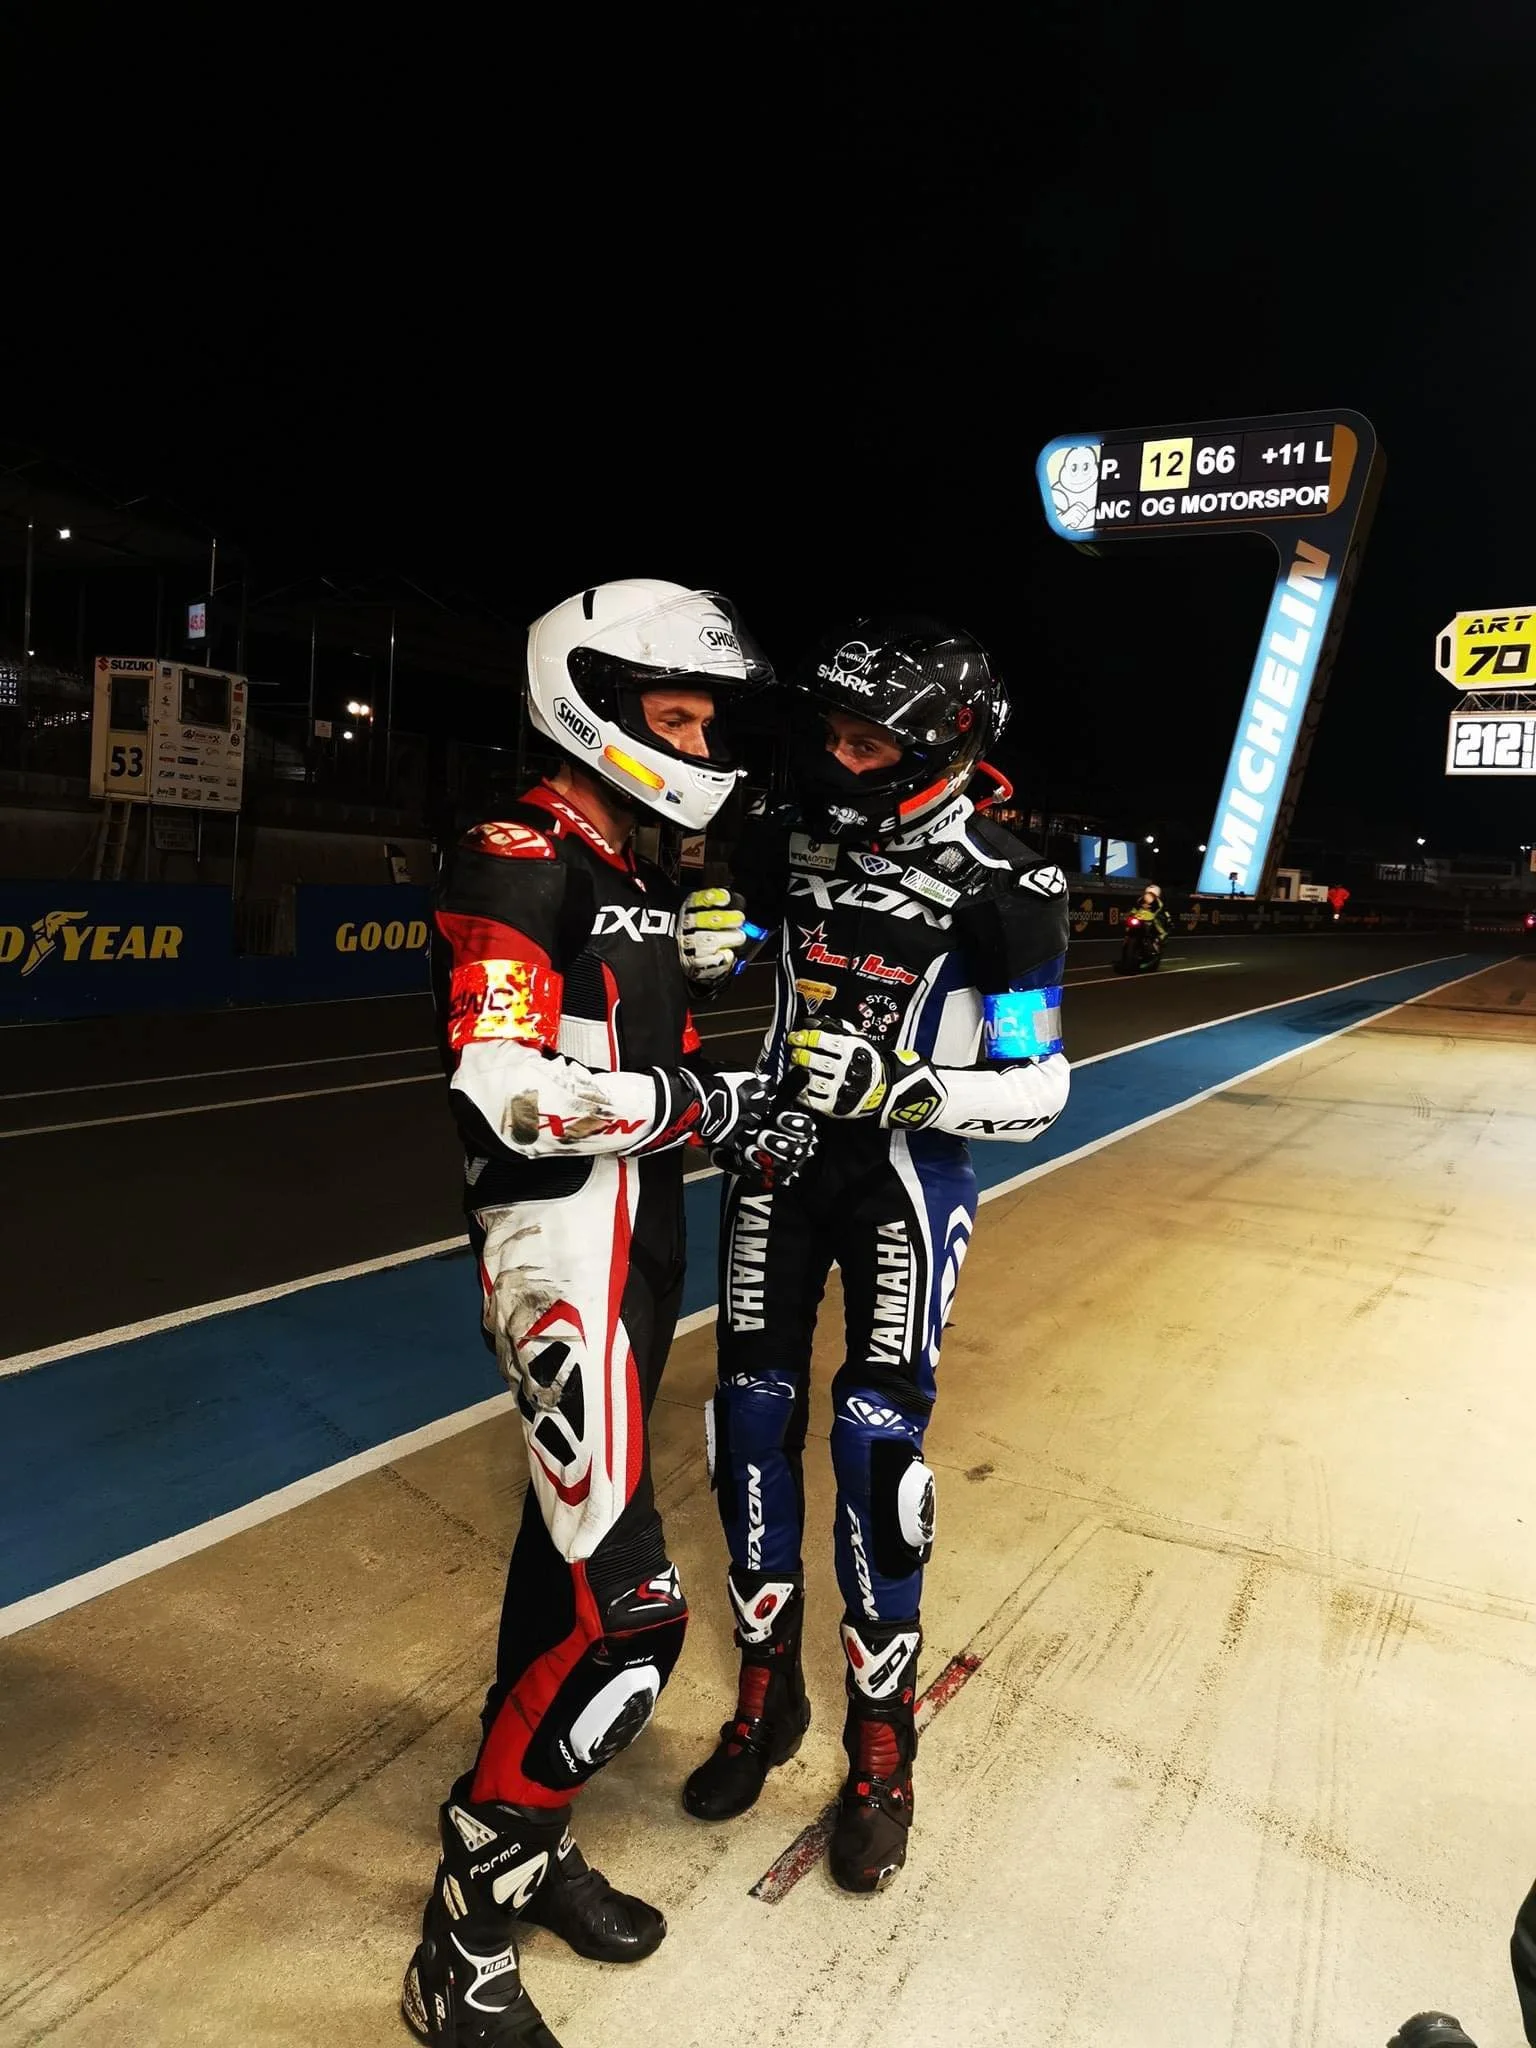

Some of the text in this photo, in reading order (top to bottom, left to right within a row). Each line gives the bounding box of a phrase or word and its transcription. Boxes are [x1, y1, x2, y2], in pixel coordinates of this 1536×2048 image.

[1150, 450, 1184, 478] 12
[1196, 446, 1236, 475] 66
[1262, 443, 1305, 466] +11
[1314, 441, 1332, 463] L
[1141, 497, 1175, 517] OG
[1181, 485, 1330, 508] MOTORSPOR
[706, 631, 740, 652] SHOE
[1463, 615, 1533, 636] ART
[110, 659, 154, 672] SUZUKI
[1463, 644, 1532, 677] 70
[817, 664, 877, 697] SHARK
[557, 703, 596, 745] SHOEI
[1212, 539, 1332, 888] MICHELIN
[110, 746, 143, 778] 53
[62, 925, 184, 961] YEAR
[335, 920, 428, 951] GOOD
[732, 1193, 774, 1333] YAMAHA
[865, 1219, 907, 1366] YAMAHA
